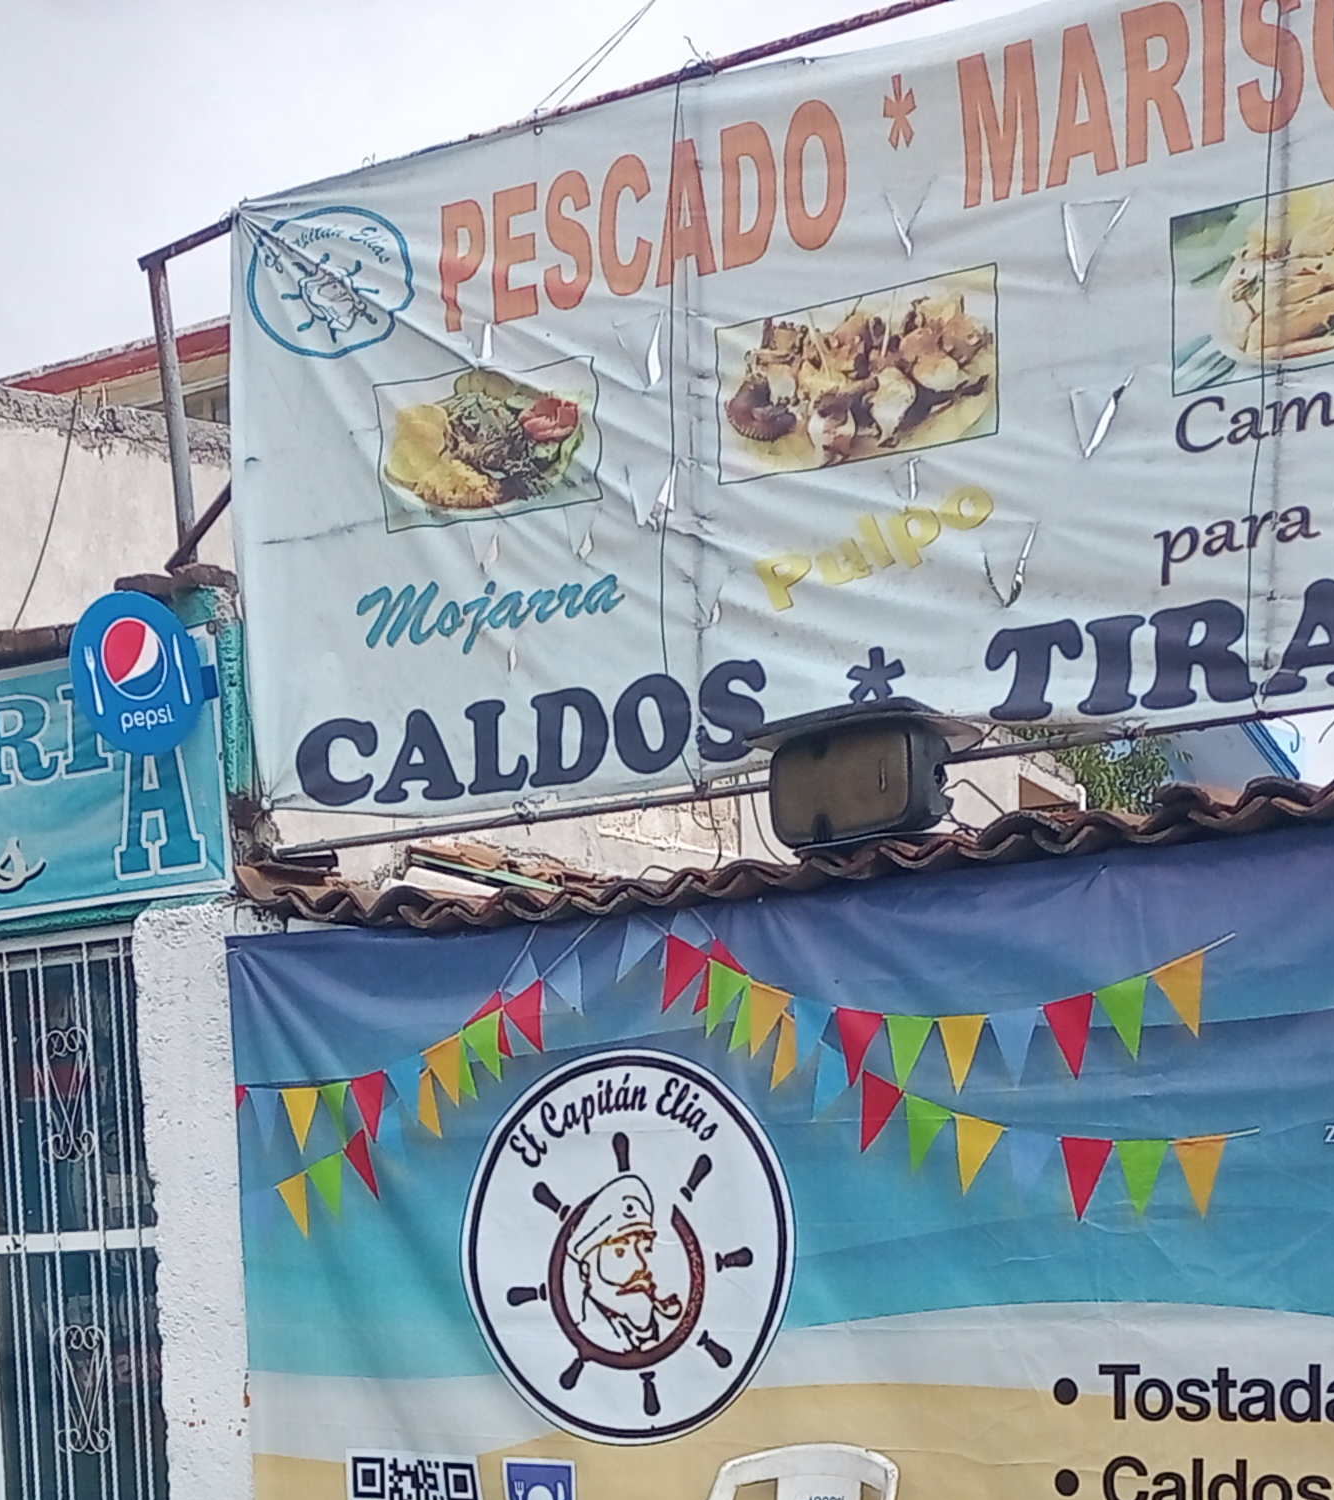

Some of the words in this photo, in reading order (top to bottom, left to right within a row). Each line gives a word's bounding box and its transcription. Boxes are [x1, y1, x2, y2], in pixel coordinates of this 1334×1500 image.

[439, 99, 848, 332] PESCADO
[753, 486, 994, 612] Pulpo
[1155, 496, 1319, 586] para
[356, 574, 625, 655] Mojarra
[120, 703, 175, 733] pepsi
[296, 659, 768, 806] CALDOS
[509, 1122, 547, 1168] El
[540, 1072, 647, 1139] Capitán
[655, 1076, 719, 1142] Elias
